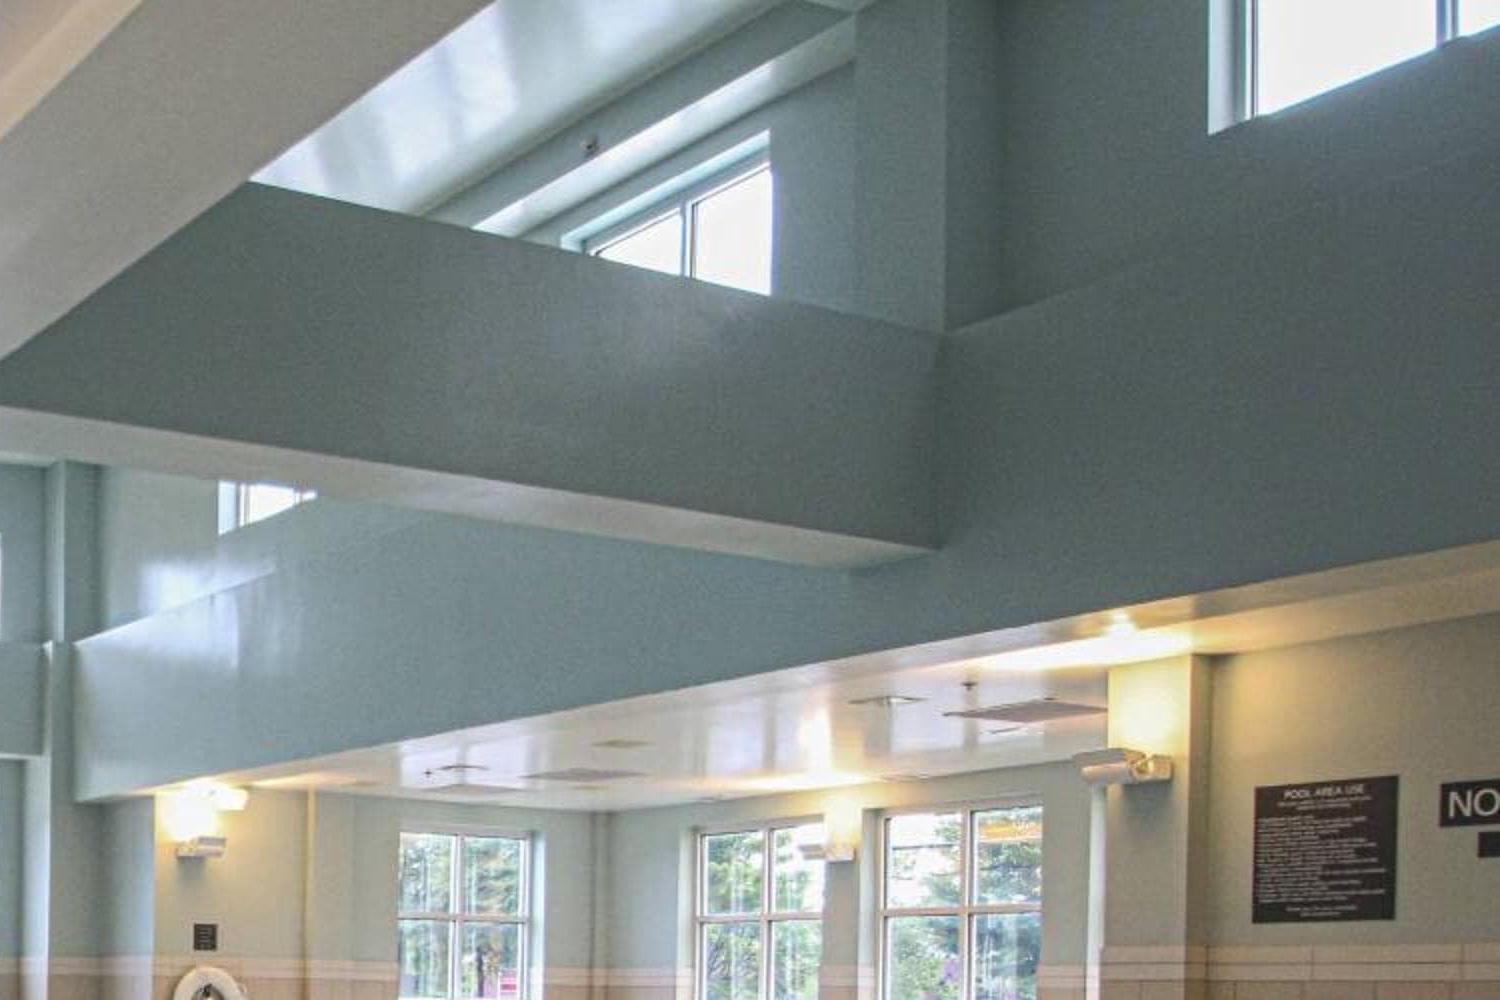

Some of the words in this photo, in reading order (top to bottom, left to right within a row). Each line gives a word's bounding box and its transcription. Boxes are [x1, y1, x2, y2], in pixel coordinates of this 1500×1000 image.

[1284, 788, 1310, 799] POOL
[1315, 786, 1342, 797] AREA
[1345, 783, 1364, 795] USE
[1448, 788, 1500, 818] NO
